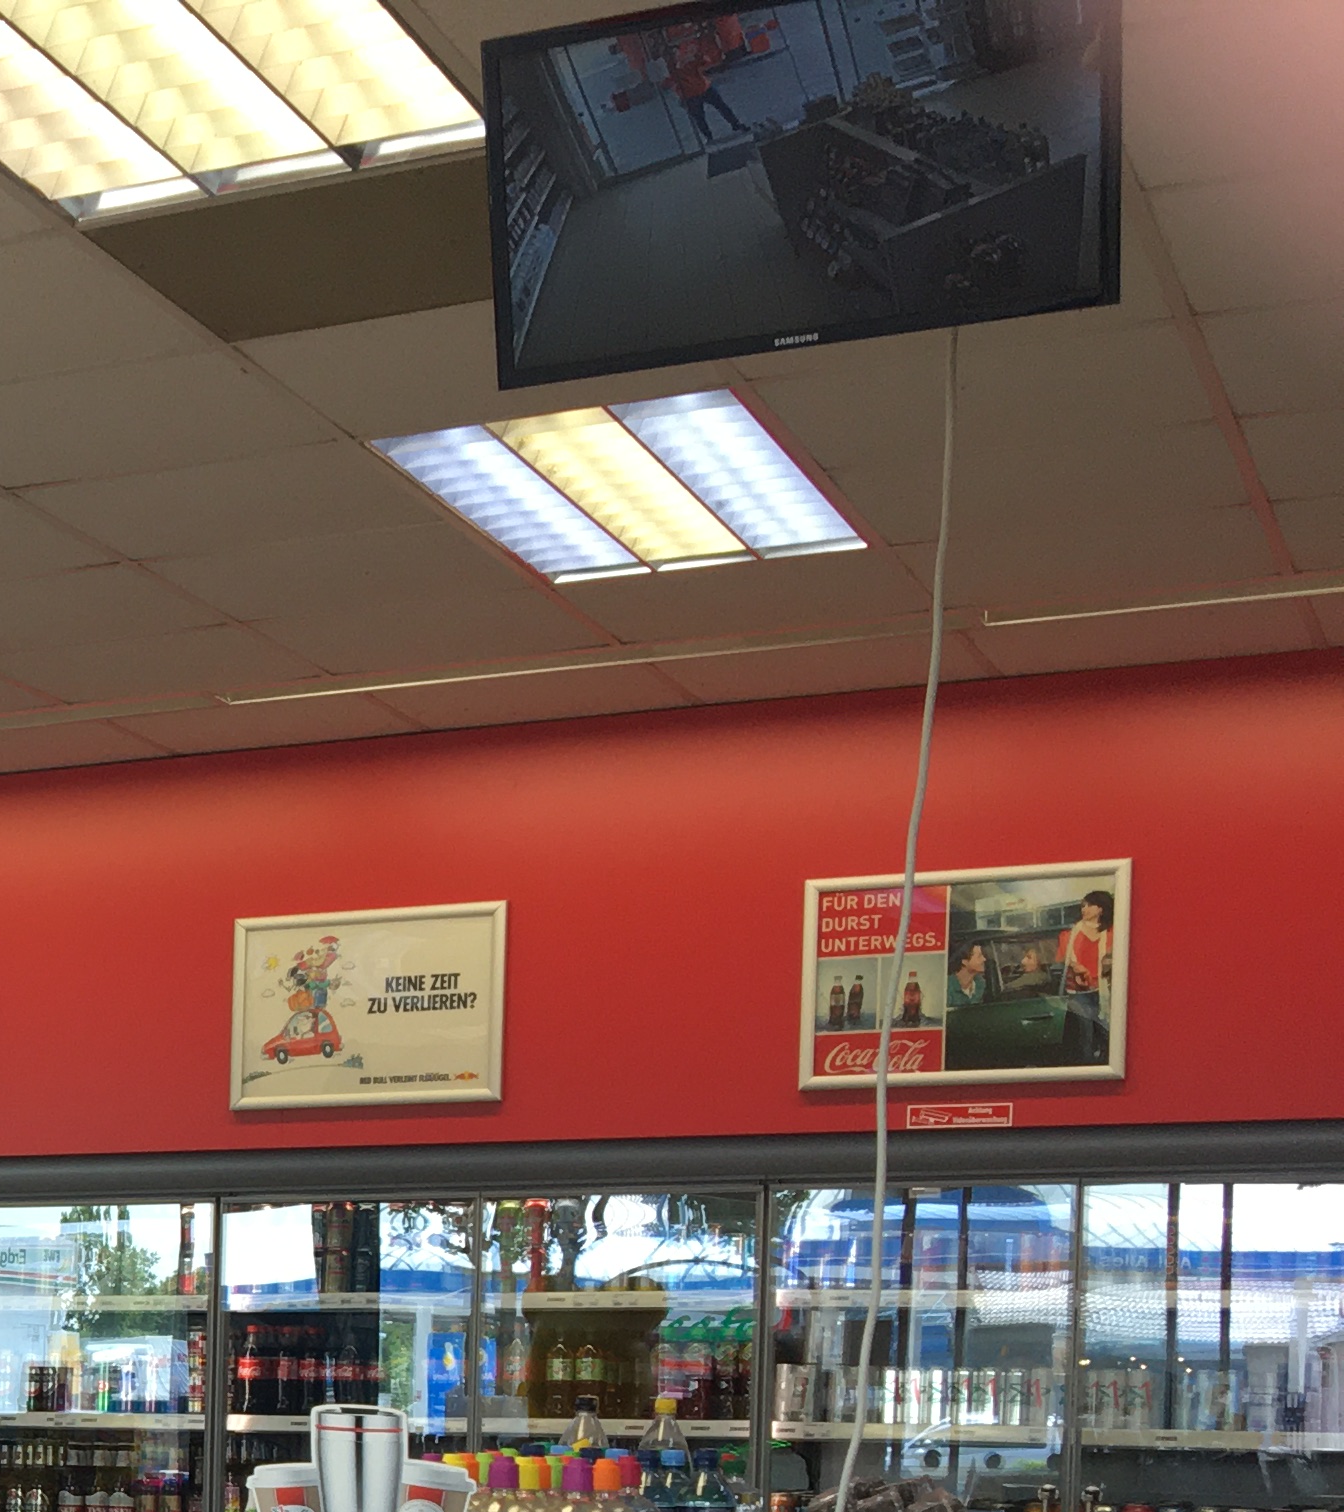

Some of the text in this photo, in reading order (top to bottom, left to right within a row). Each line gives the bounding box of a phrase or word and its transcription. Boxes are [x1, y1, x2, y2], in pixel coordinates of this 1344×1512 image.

[774, 333, 819, 347] SAMSUNG
[823, 892, 901, 911] FÜR DEN
[822, 914, 882, 933] DURST
[384, 973, 461, 994] KEINE ZEIT
[367, 992, 477, 1014] ZU VERLIEREN?
[824, 1039, 930, 1074] CocaCola
